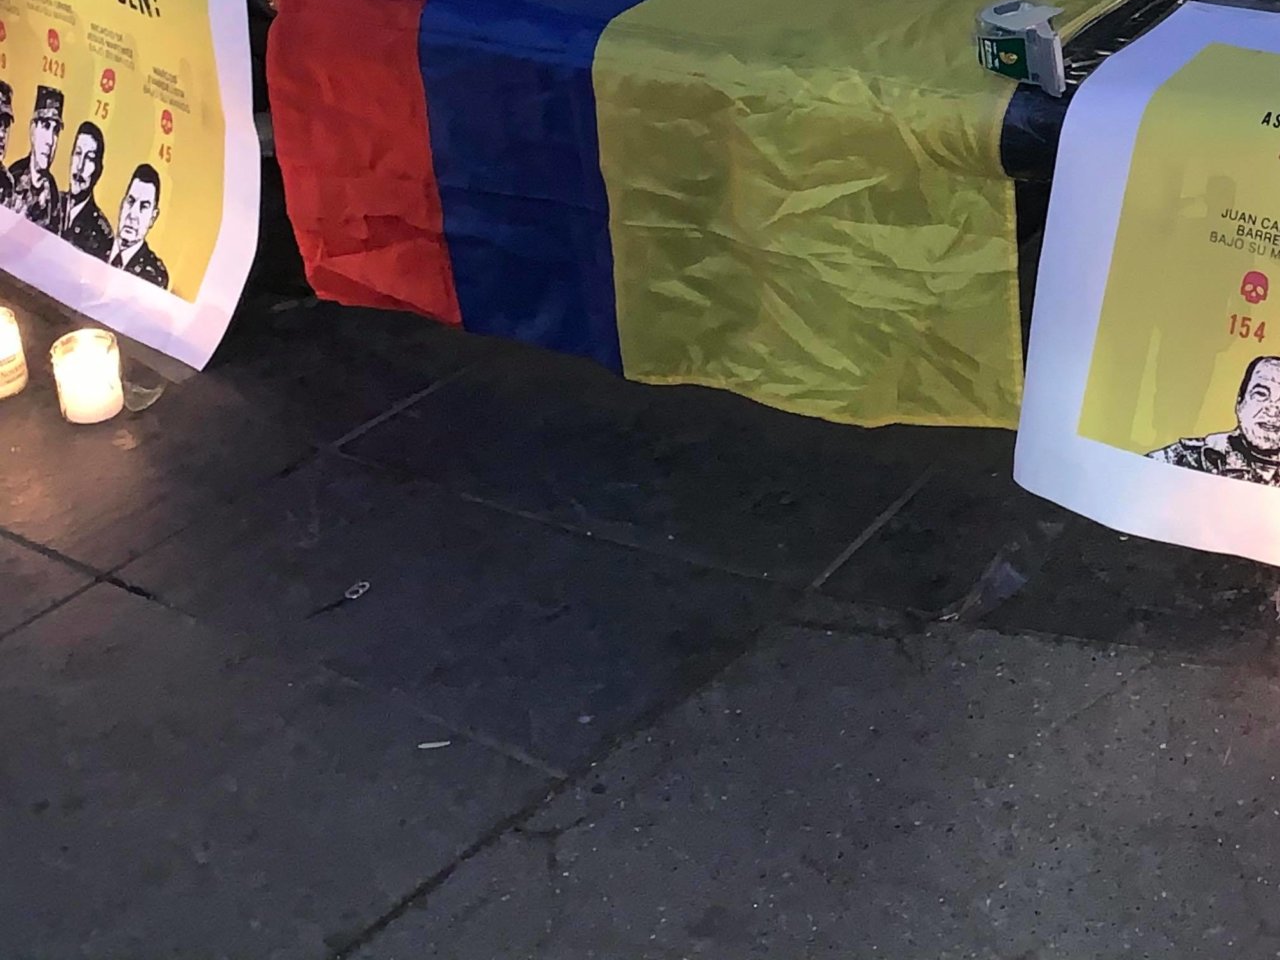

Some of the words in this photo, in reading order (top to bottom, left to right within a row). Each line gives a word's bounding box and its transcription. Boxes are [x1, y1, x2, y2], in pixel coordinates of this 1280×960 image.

[42, 55, 66, 78] 2429
[94, 99, 110, 120] 75
[158, 143, 172, 163] 45
[1220, 208, 1258, 228] JUAN
[1209, 231, 1245, 252] BAJO
[1248, 240, 1268, 256] SU
[1228, 313, 1267, 344] 154
